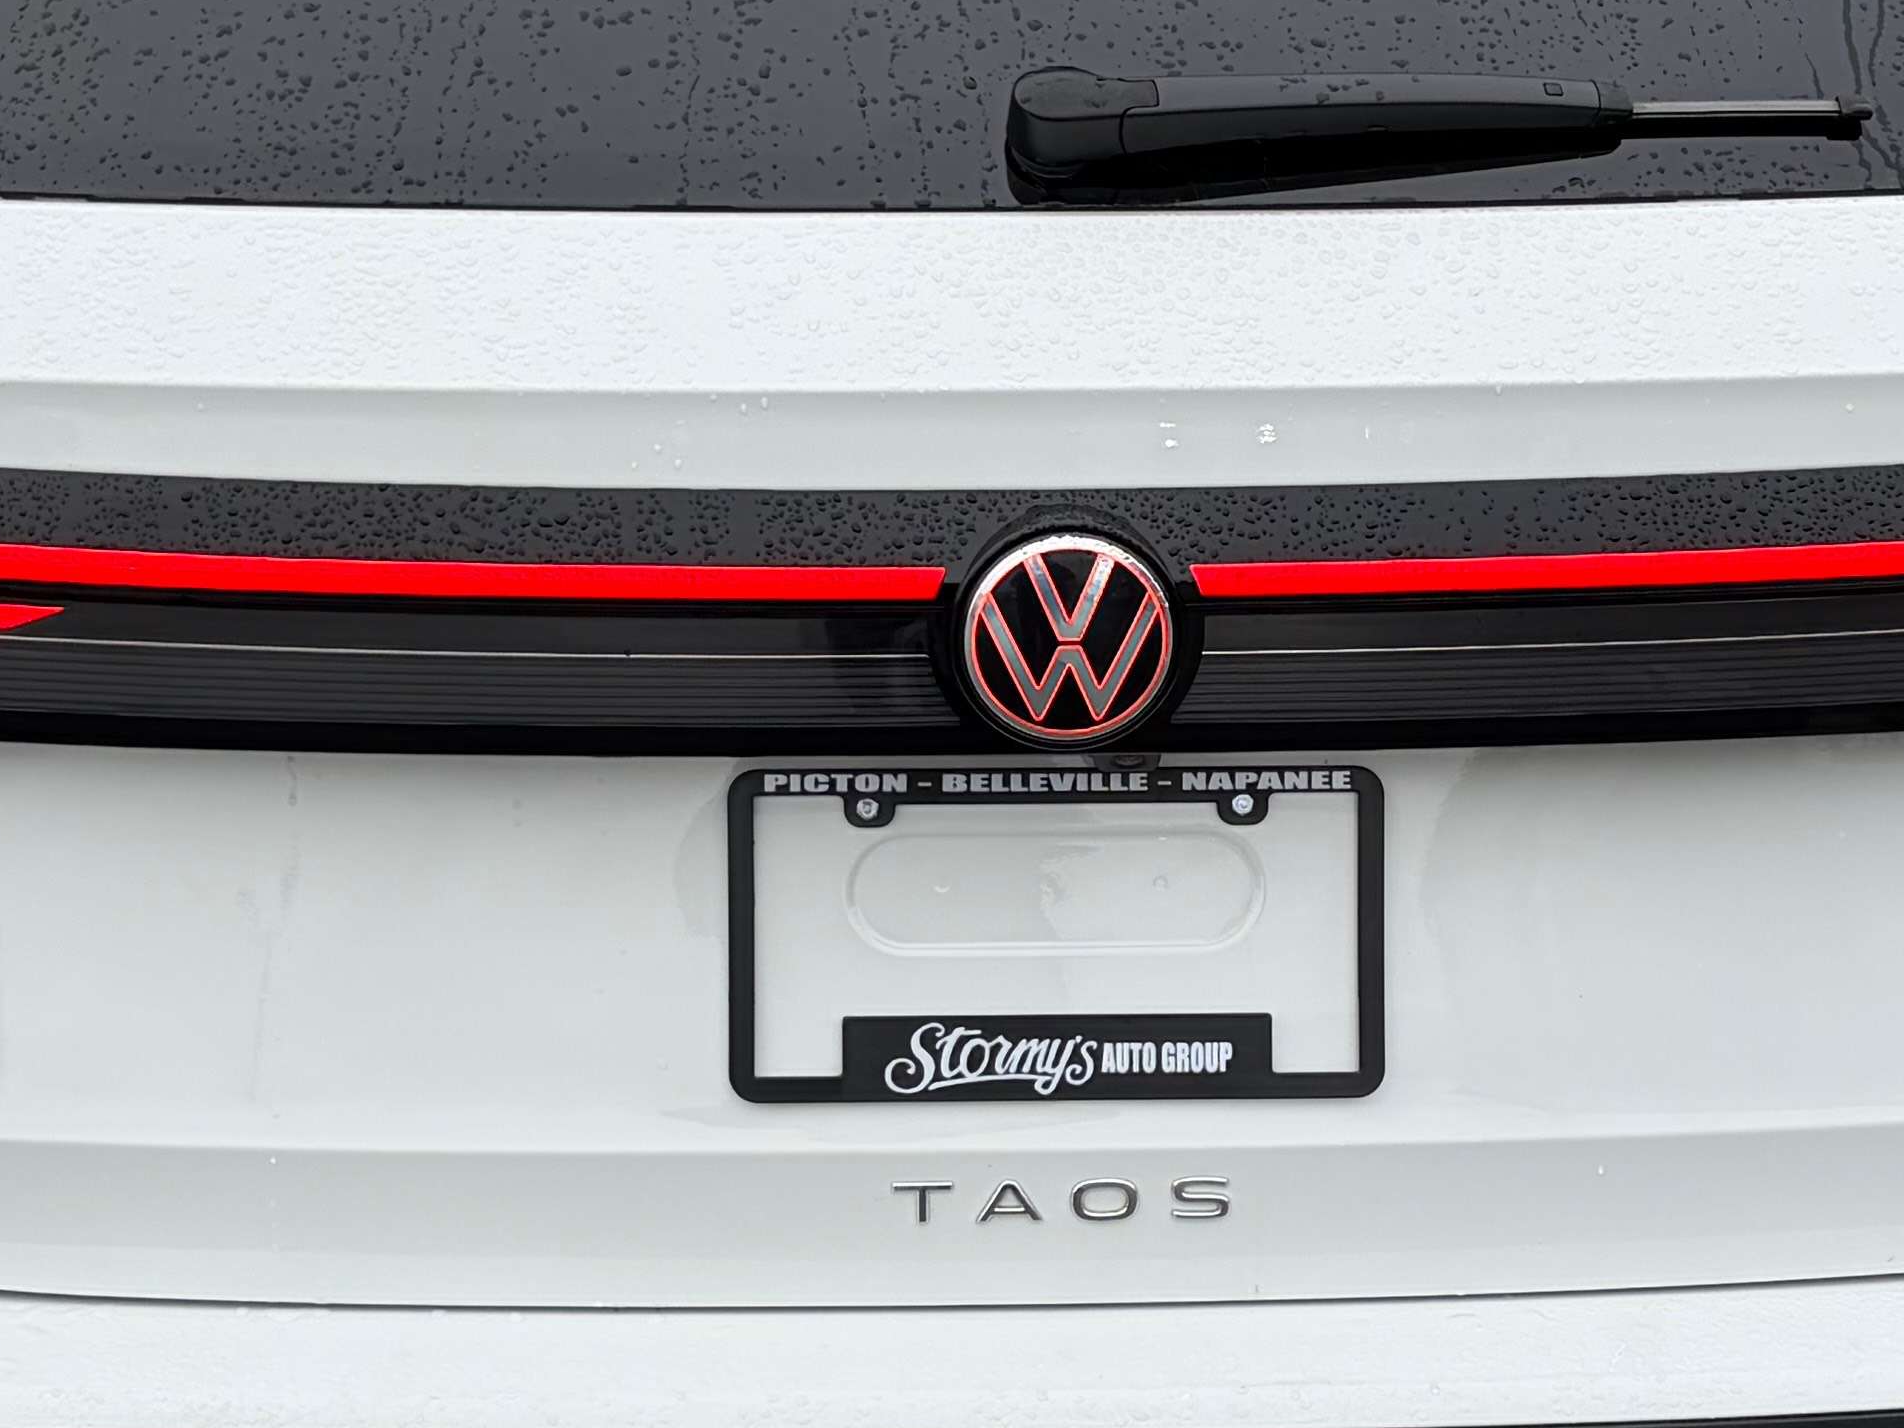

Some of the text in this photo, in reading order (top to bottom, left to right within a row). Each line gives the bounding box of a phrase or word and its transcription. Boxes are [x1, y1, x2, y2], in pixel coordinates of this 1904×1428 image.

[976, 550, 1167, 723] VW
[763, 773, 908, 793] PICTON
[941, 772, 1149, 793] BELLEVILLE
[1181, 771, 1353, 791] NAPANEE
[884, 1022, 1233, 1096] Stormy's AUTO GROUP
[891, 1175, 1230, 1223] TAOS
